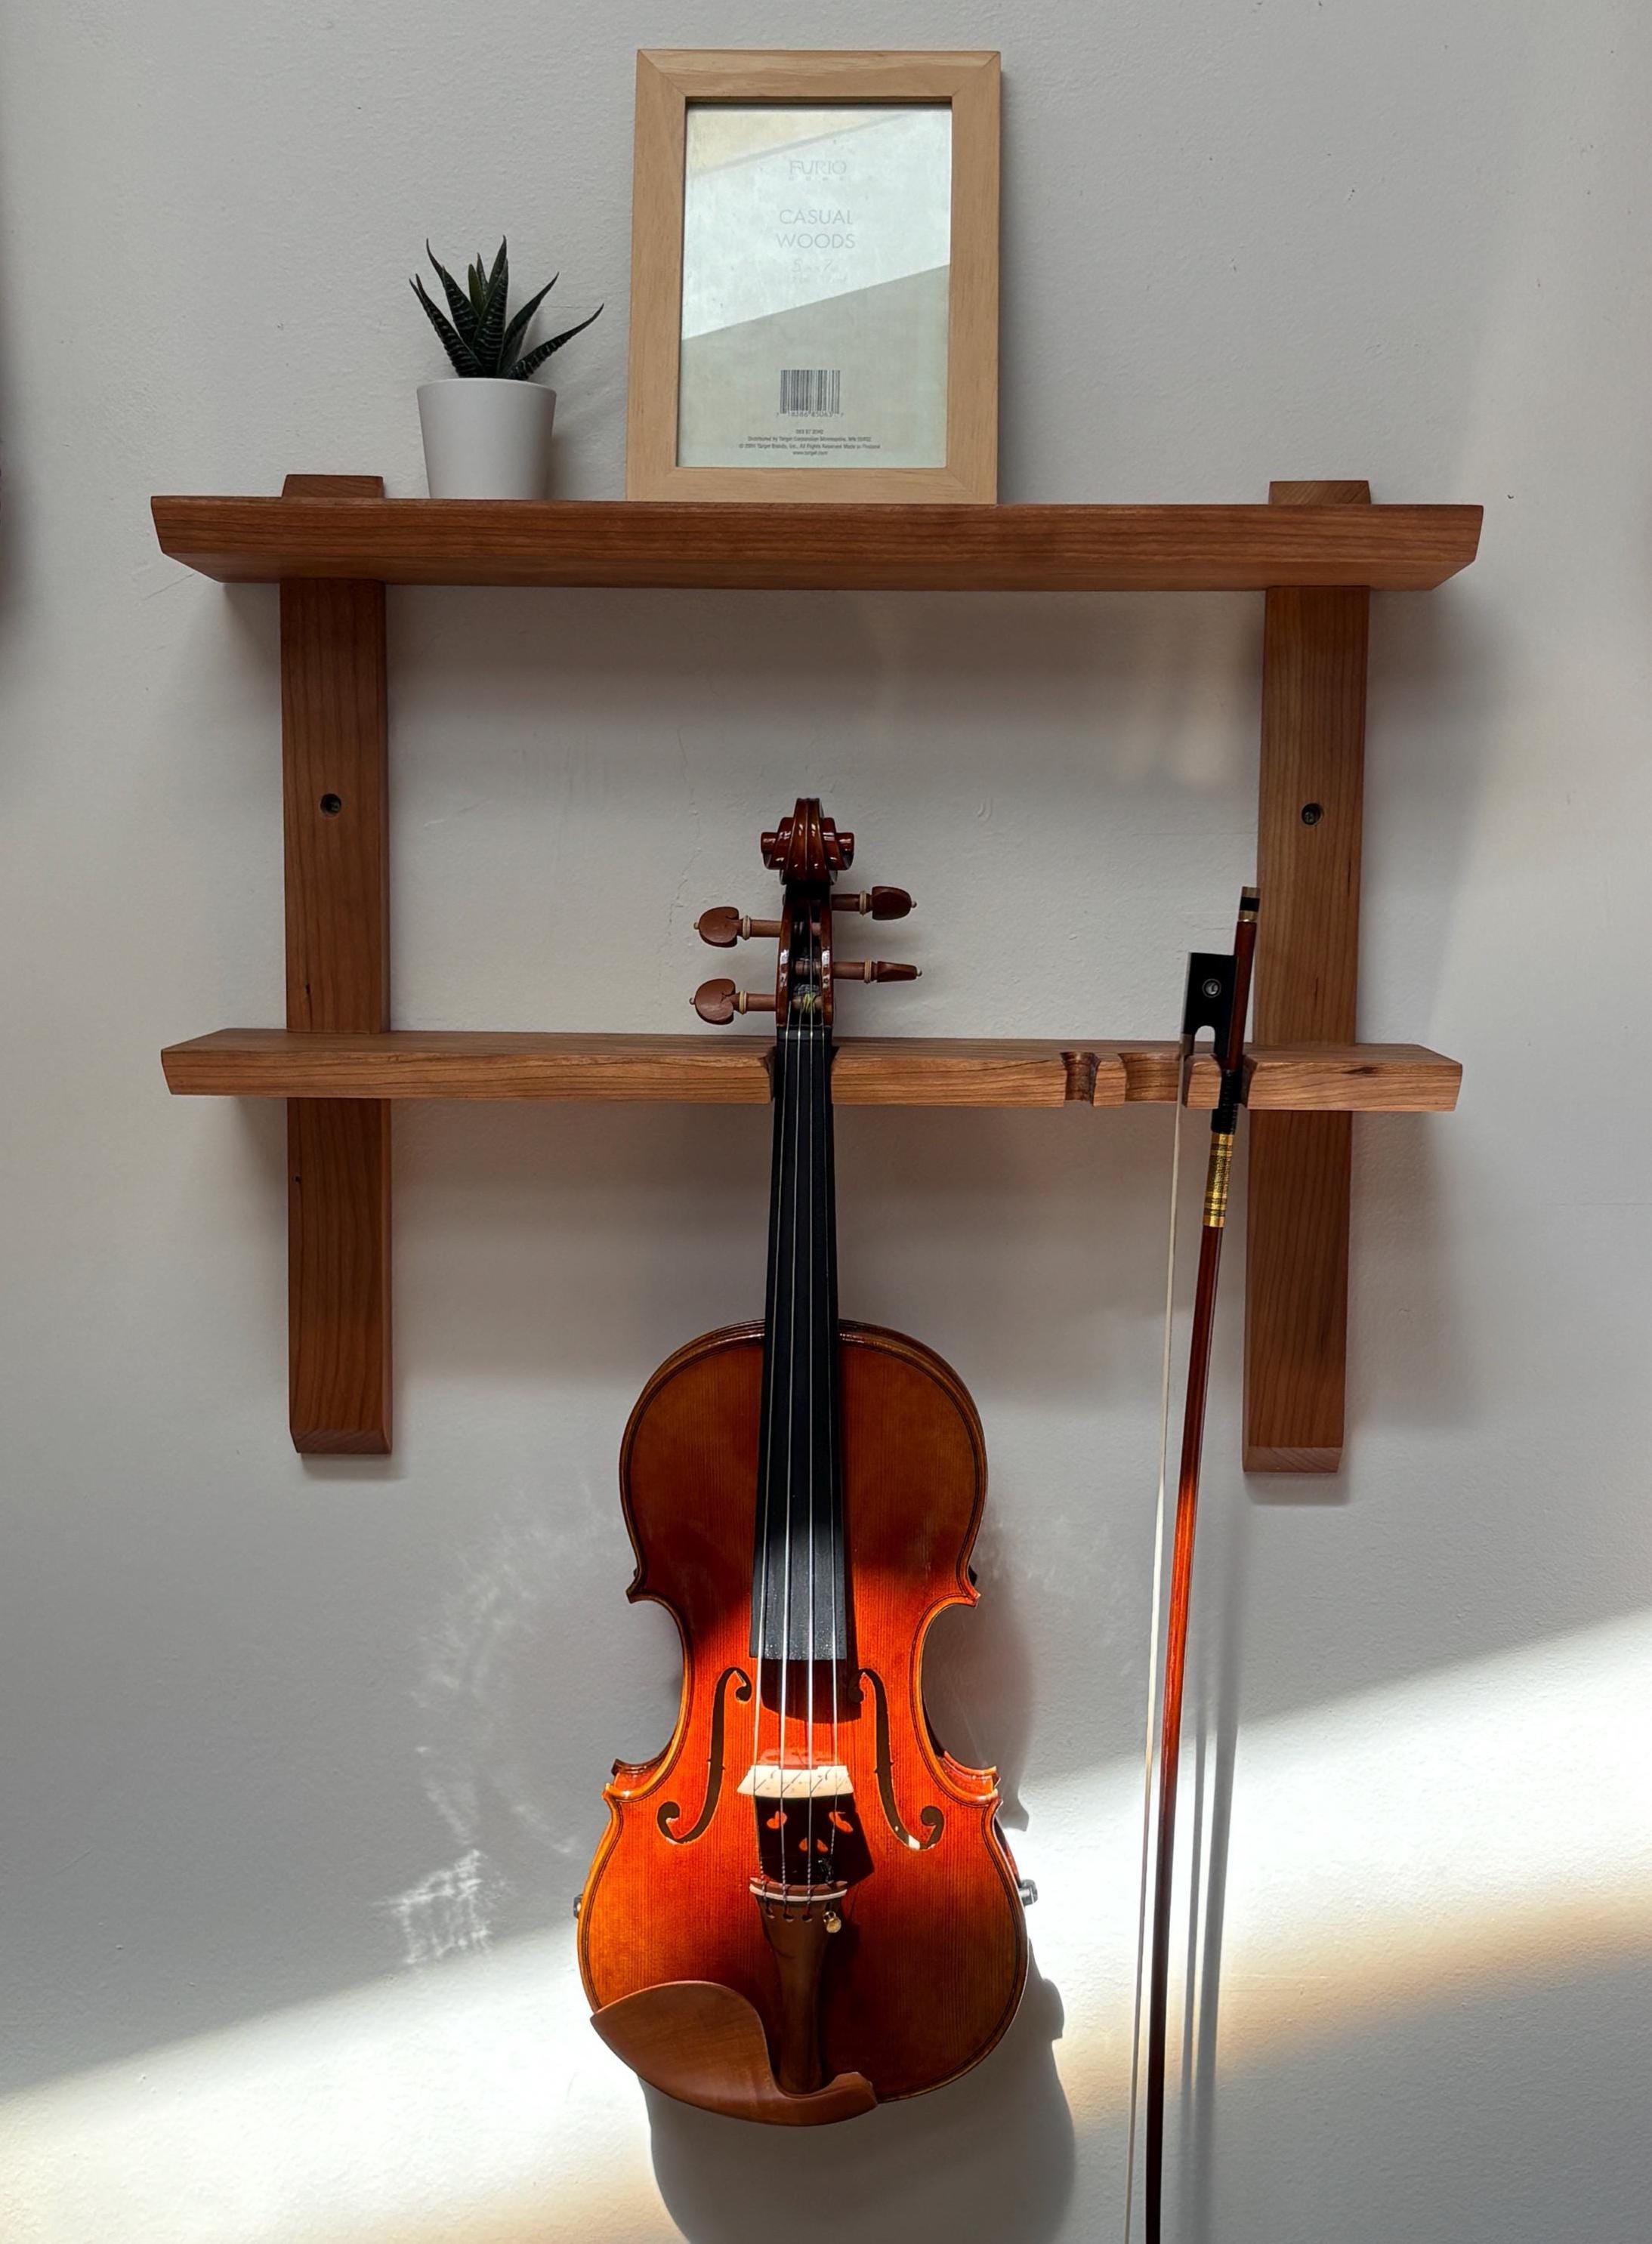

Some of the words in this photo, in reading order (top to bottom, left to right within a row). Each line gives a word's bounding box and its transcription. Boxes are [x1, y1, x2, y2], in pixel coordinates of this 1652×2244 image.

[789, 160, 847, 174] FURIO
[780, 208, 853, 224] CASUAL
[776, 233, 855, 248] WOODS
